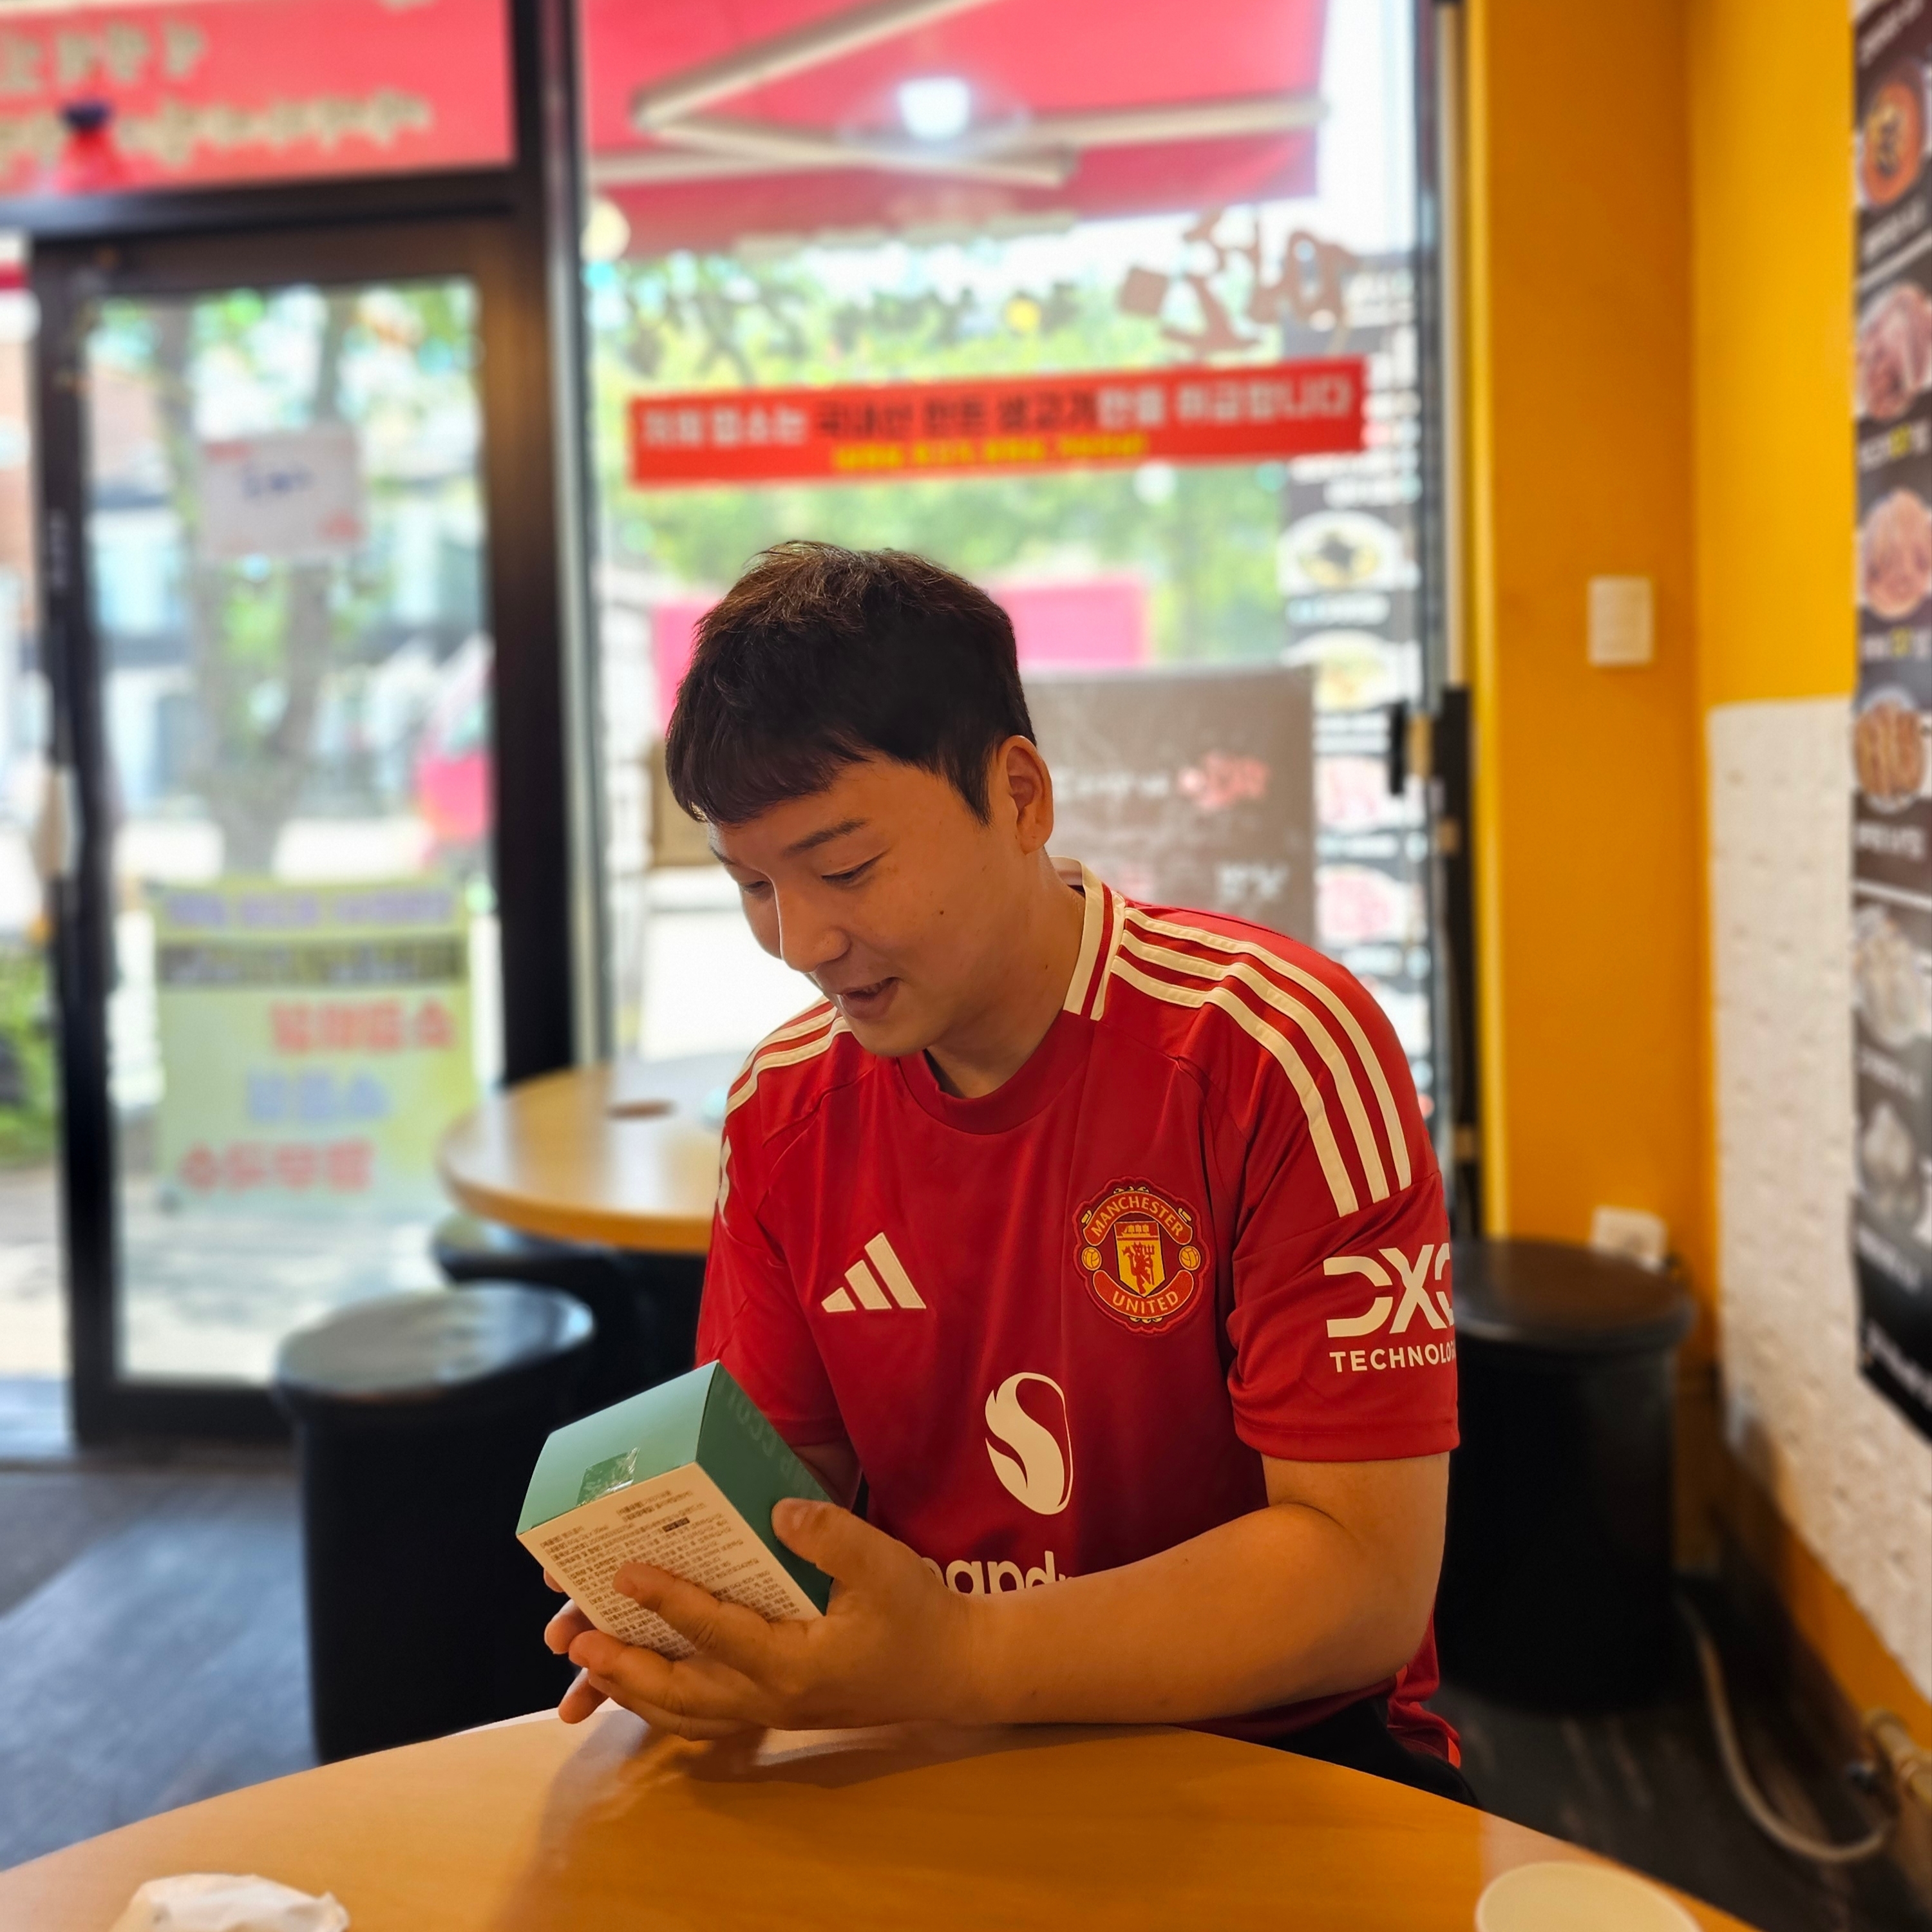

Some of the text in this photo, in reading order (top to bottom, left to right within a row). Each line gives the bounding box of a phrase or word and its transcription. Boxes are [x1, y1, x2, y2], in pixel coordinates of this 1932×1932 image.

[1177, 377, 1349, 420] 취급합니다
[1091, 1196, 1184, 1237] MANCHESTER
[1112, 1291, 1179, 1314] UNITED
